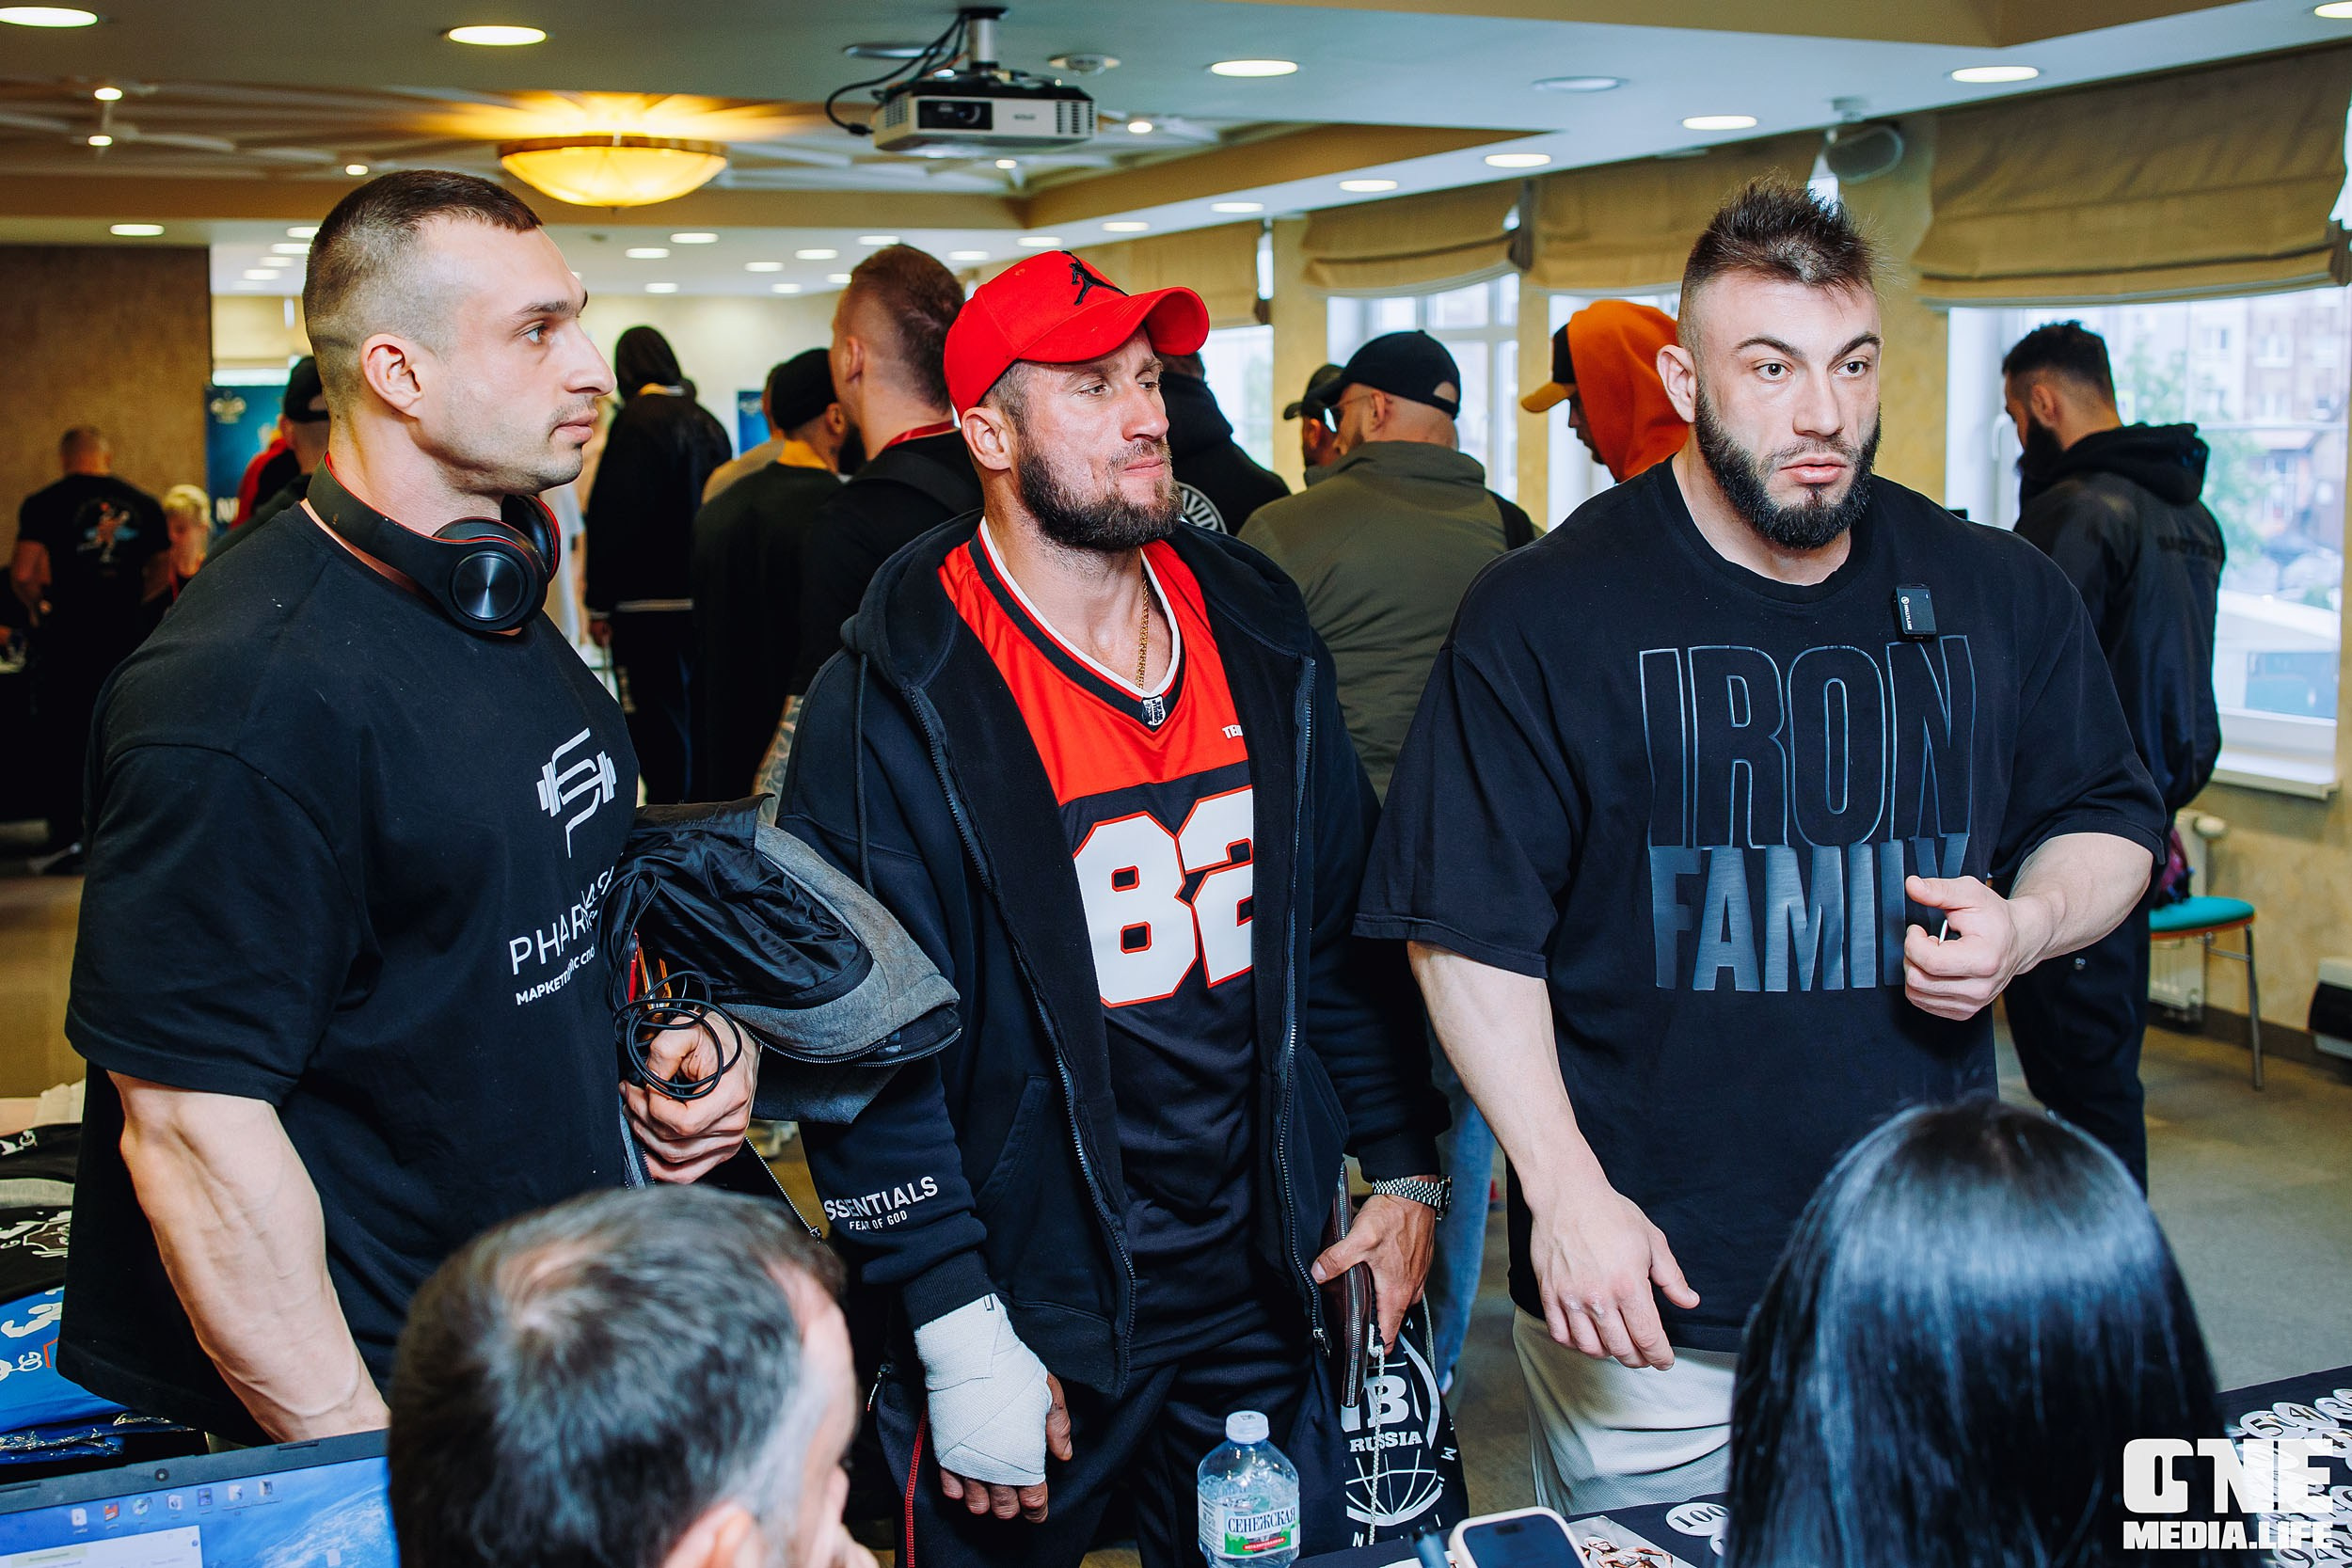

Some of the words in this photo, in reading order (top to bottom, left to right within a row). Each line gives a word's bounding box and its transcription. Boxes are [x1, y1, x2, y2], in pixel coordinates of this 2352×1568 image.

[1639, 634, 1977, 849] IRON
[1073, 784, 1254, 1008] 82
[850, 1220, 871, 1230] FEAR
[871, 1218, 883, 1229] OF
[886, 1210, 908, 1226] GOD
[1349, 1431, 1422, 1453] RUSSIA
[1228, 1507, 1295, 1533] СЕНЕЖСКАЯ
[1672, 1505, 1729, 1528] 100
